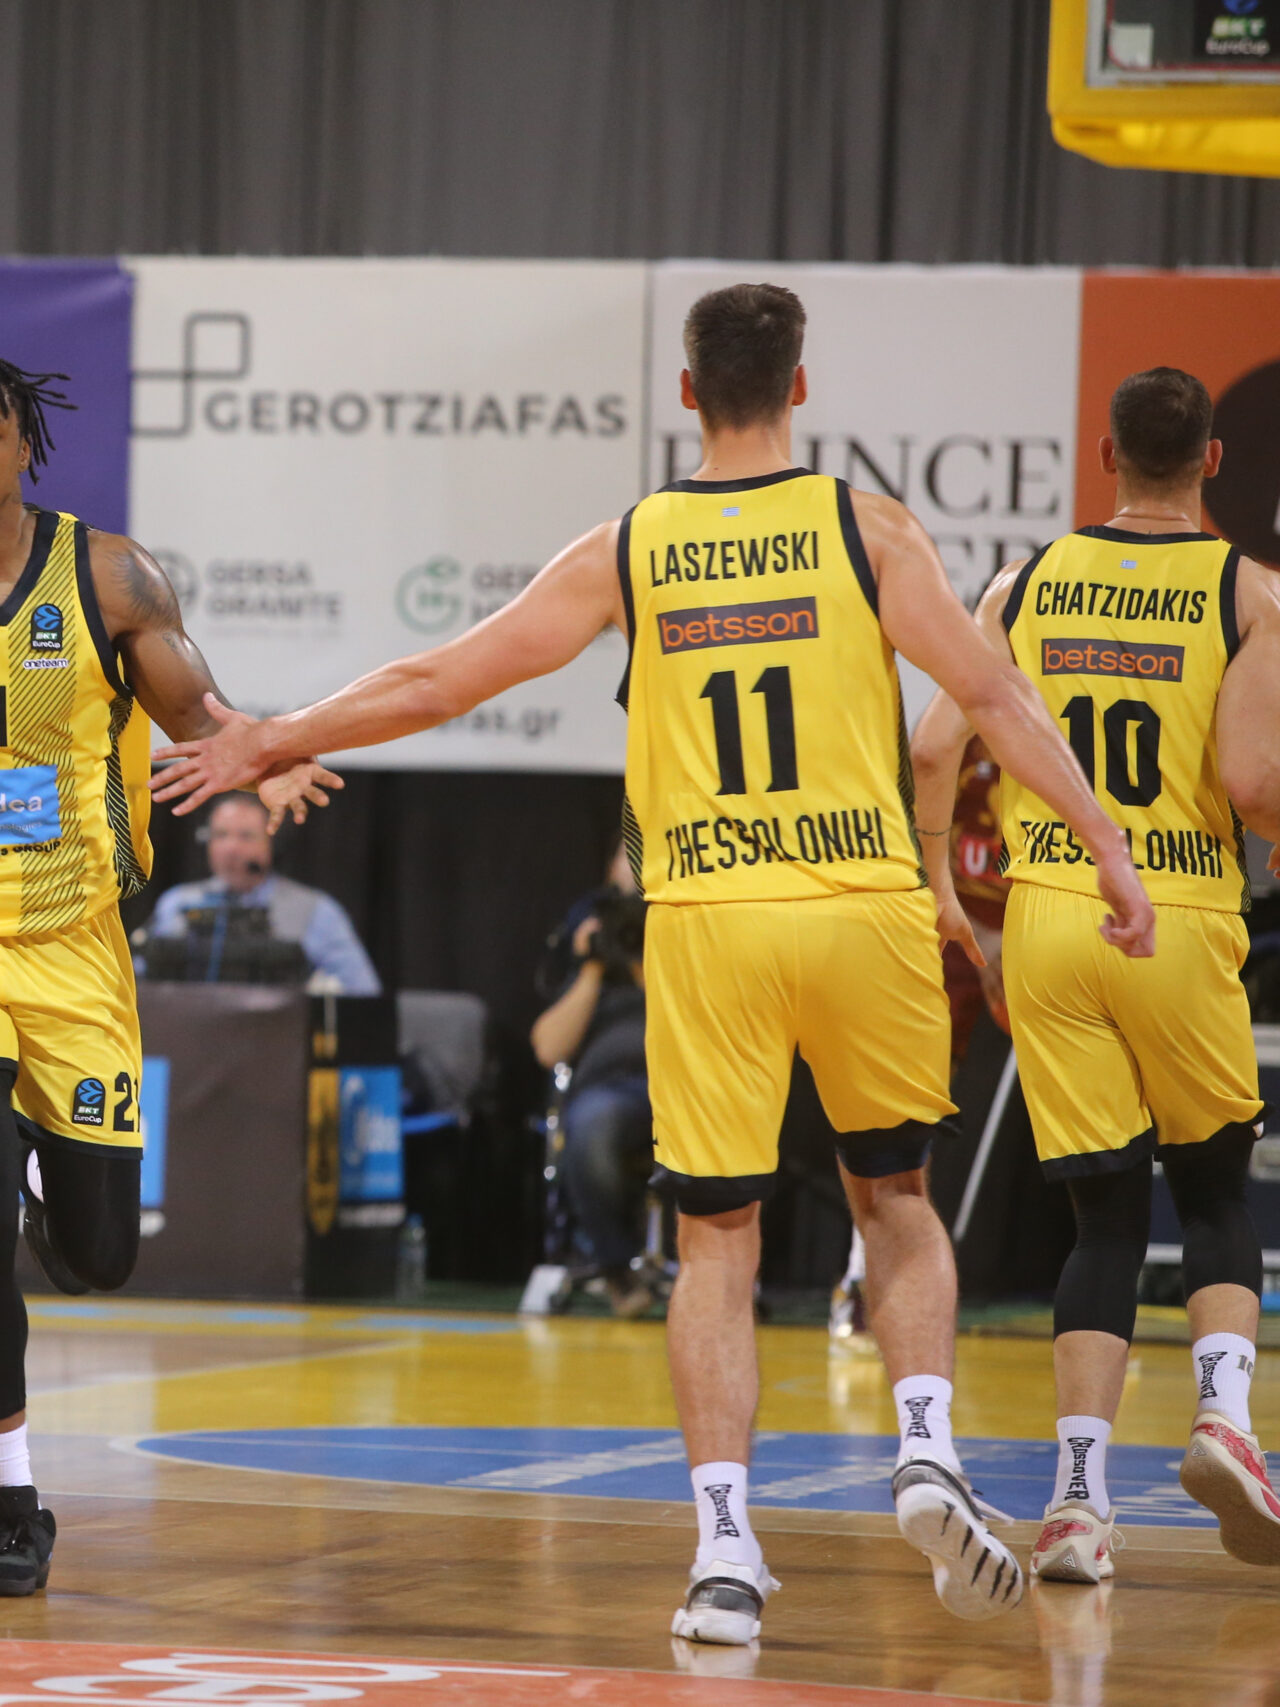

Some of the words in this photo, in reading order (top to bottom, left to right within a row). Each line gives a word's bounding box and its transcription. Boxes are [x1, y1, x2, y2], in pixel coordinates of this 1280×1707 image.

[204, 391, 628, 437] GEROTZIAFAS
[657, 432, 1062, 518] PINCE
[650, 531, 819, 588] LASZEWSKI
[207, 595, 344, 620] GRANITE
[660, 607, 815, 649] betsson
[1035, 581, 1208, 625] CHATZIDAKIS
[1043, 645, 1180, 677] betsson
[699, 666, 800, 797] 11
[1059, 695, 1162, 808] 10
[12, 840, 61, 855] GROUP
[666, 807, 888, 882] THESSALONIKI
[1019, 820, 1223, 879] THESLONIKI
[73, 1114, 102, 1123] EuroCup
[1064, 1436, 1096, 1501] CROSSOVER
[703, 1483, 740, 1540] CROSSOVER
